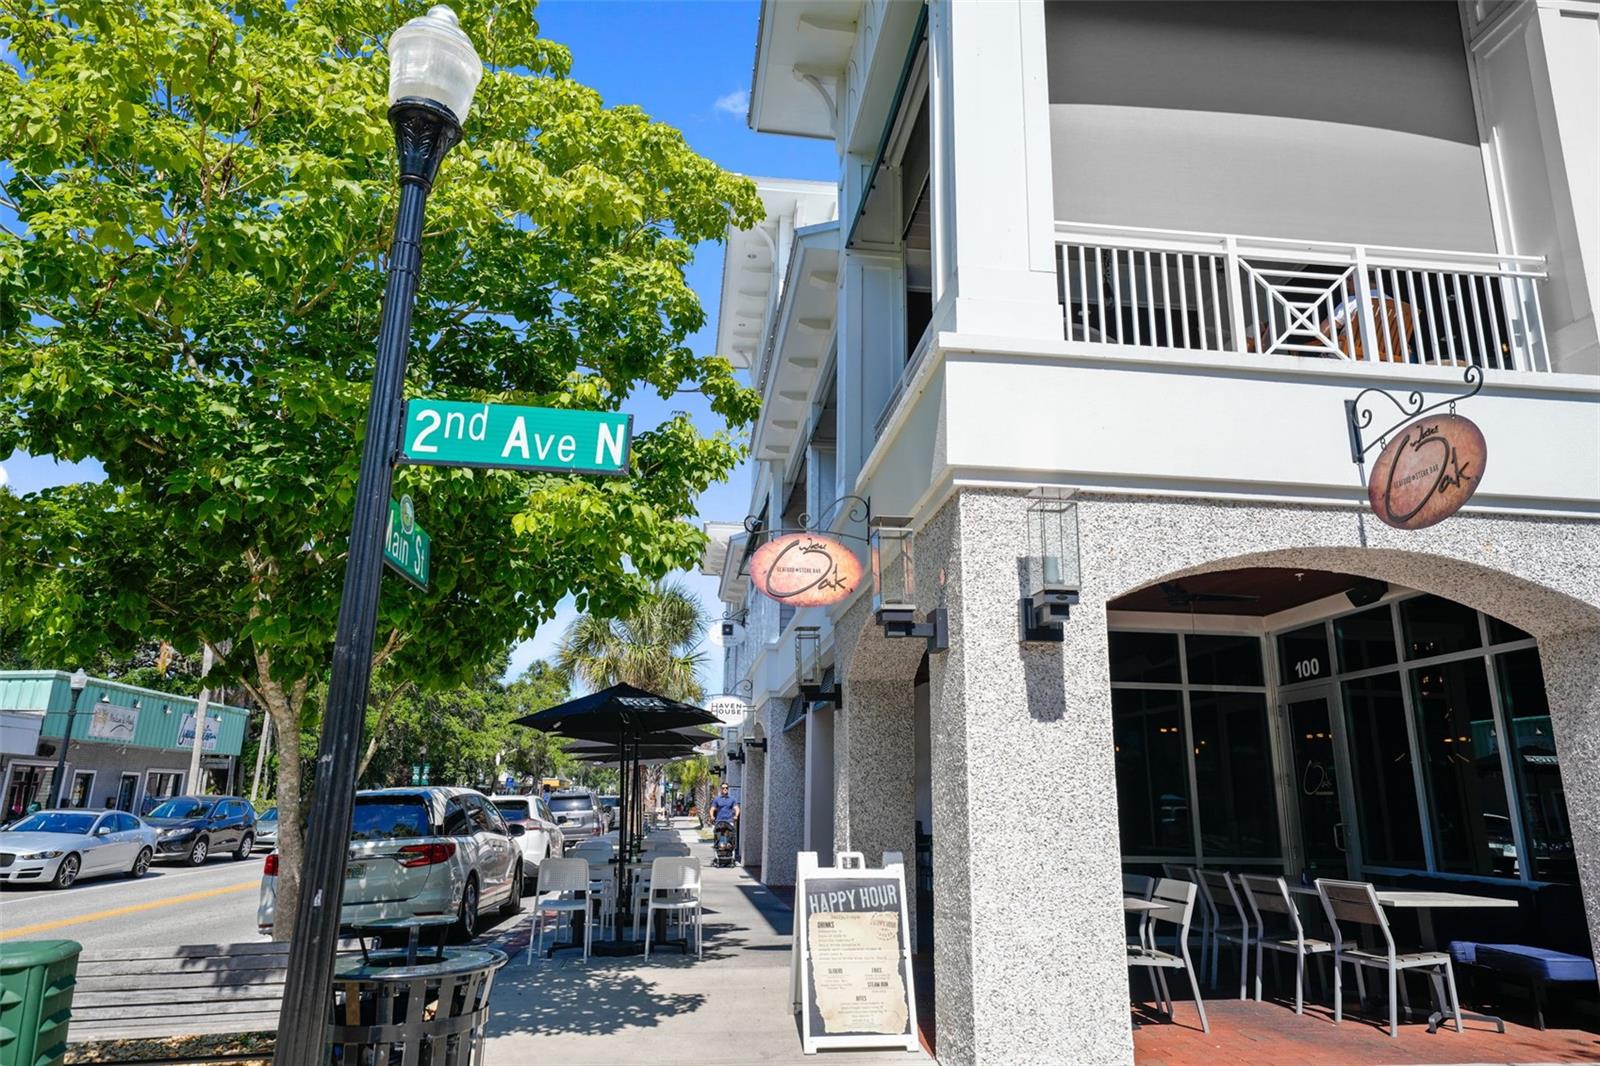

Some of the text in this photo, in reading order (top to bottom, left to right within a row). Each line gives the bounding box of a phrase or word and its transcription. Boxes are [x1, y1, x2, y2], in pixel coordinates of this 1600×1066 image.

[411, 405, 625, 466] 2nd Ave N
[414, 534, 425, 579] St
[1295, 658, 1320, 679] 100
[711, 708, 742, 716] HOUSE
[809, 884, 898, 913] HAPPY HOUR
[817, 921, 835, 929] DRINKS
